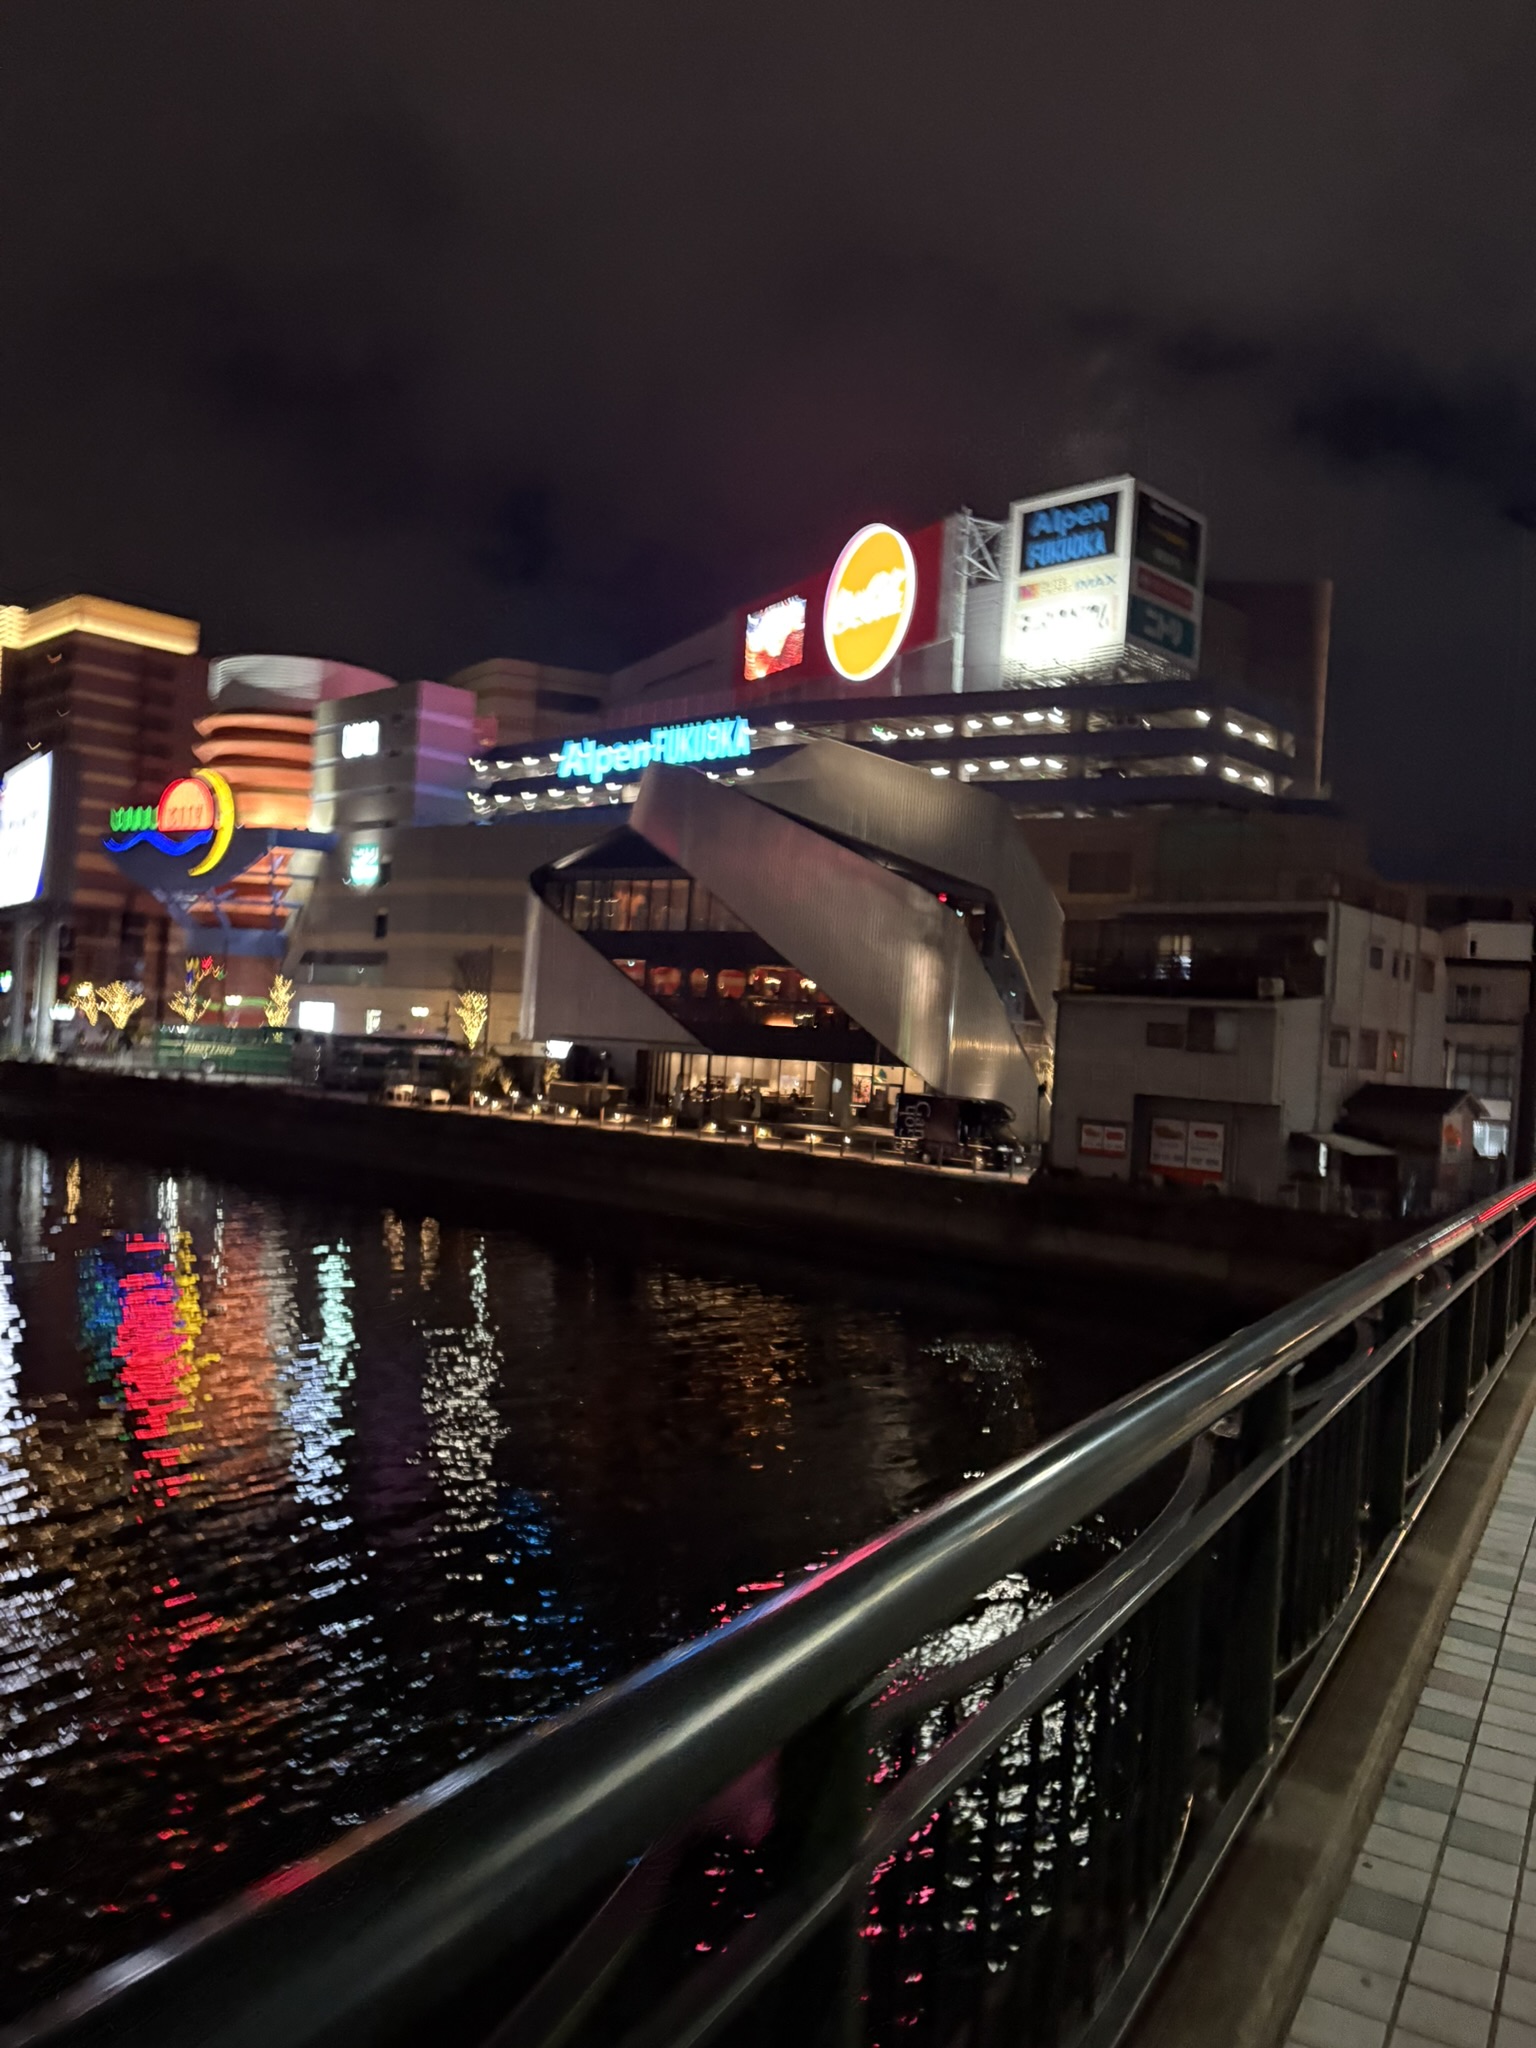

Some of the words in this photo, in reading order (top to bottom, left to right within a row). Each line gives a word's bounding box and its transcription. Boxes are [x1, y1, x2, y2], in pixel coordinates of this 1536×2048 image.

[1028, 501, 1110, 537] Alpen
[1025, 528, 1107, 569] FUKUOKA
[557, 738, 650, 784] Alpen
[651, 716, 751, 764] FUKUOKA
